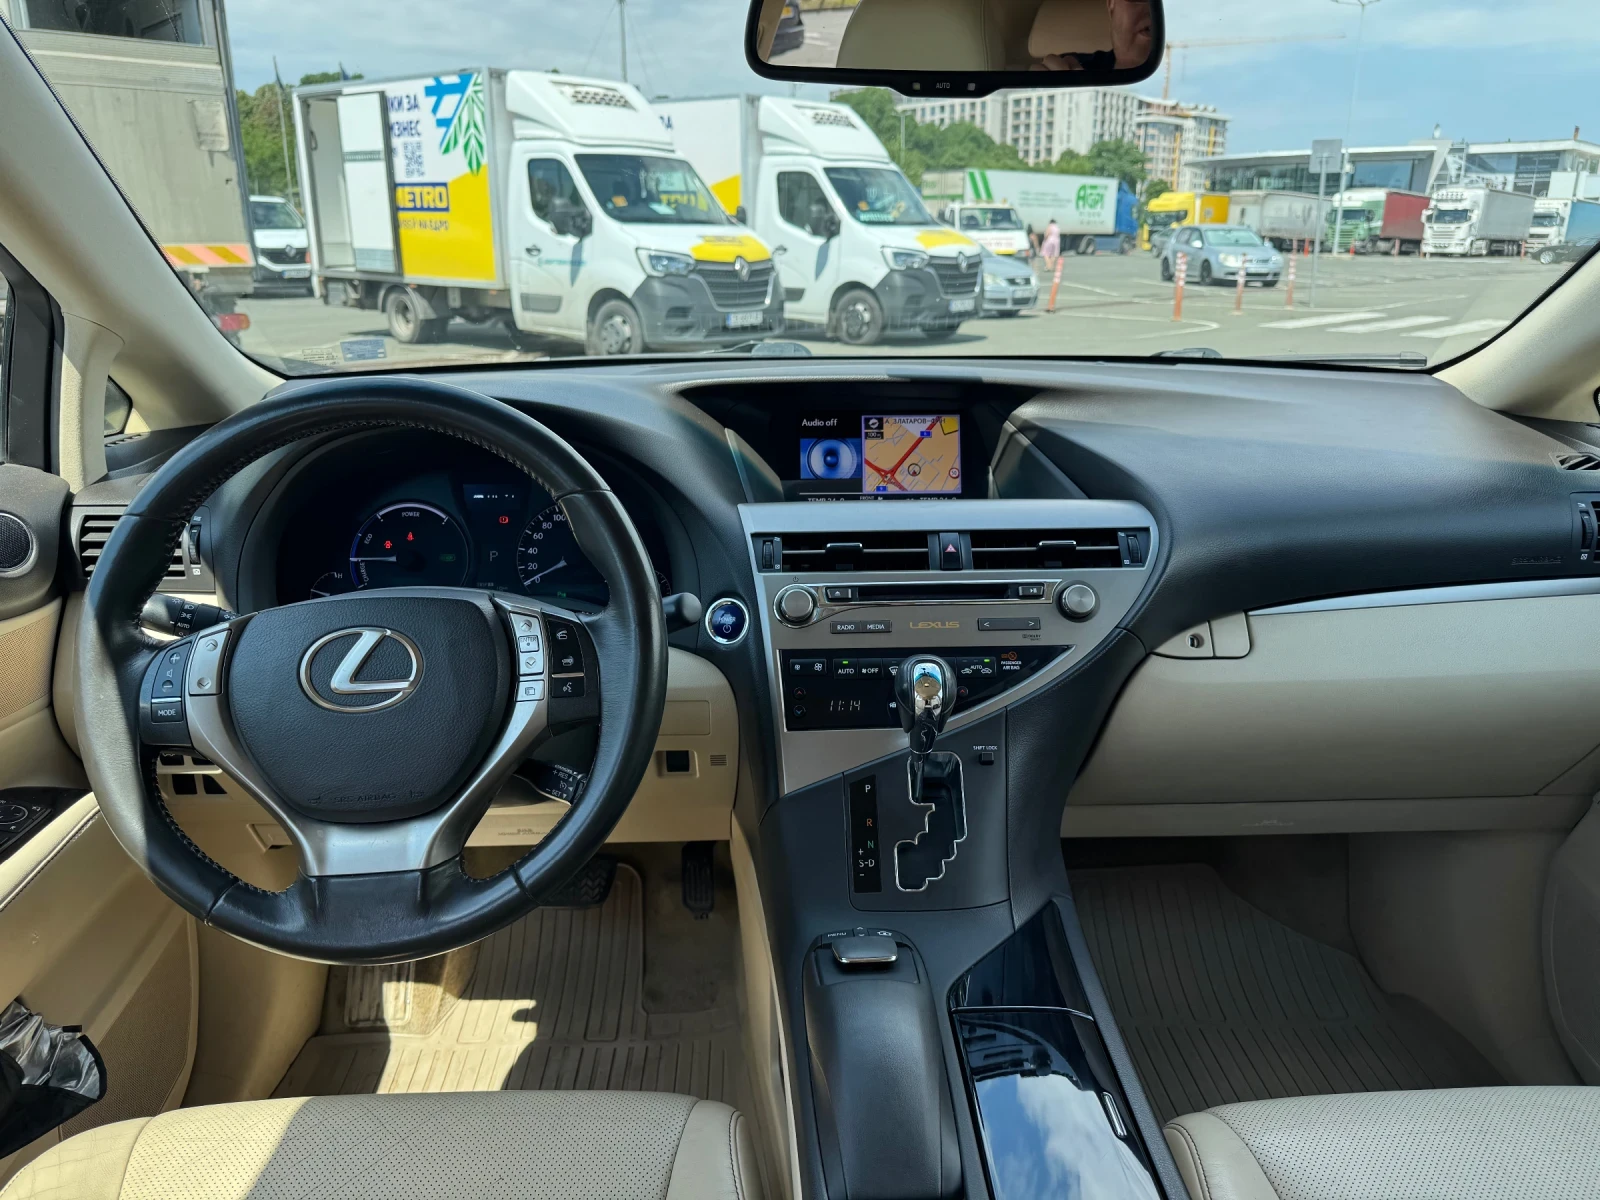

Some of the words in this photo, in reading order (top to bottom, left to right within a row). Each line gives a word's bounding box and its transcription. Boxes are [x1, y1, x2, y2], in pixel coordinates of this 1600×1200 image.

[801, 418, 824, 427] Audio
[826, 418, 838, 426] off
[552, 514, 567, 522] 100
[542, 522, 553, 530] 80
[363, 533, 373, 545] ECO
[532, 532, 544, 541] 60
[527, 547, 538, 555] 40
[489, 550, 499, 562] P
[527, 562, 538, 571] 20
[359, 561, 370, 582] CHARGE
[535, 575, 541, 584] 0
[176, 621, 191, 630] AUTO
[836, 623, 855, 631] RADIO
[909, 621, 960, 629] LEXUS
[829, 699, 861, 711] 11:14
[157, 708, 177, 717] MODE
[557, 771, 569, 780] RES
[864, 784, 871, 793] P
[866, 818, 873, 827] R
[867, 840, 875, 849] N
[858, 858, 875, 868] S-D
